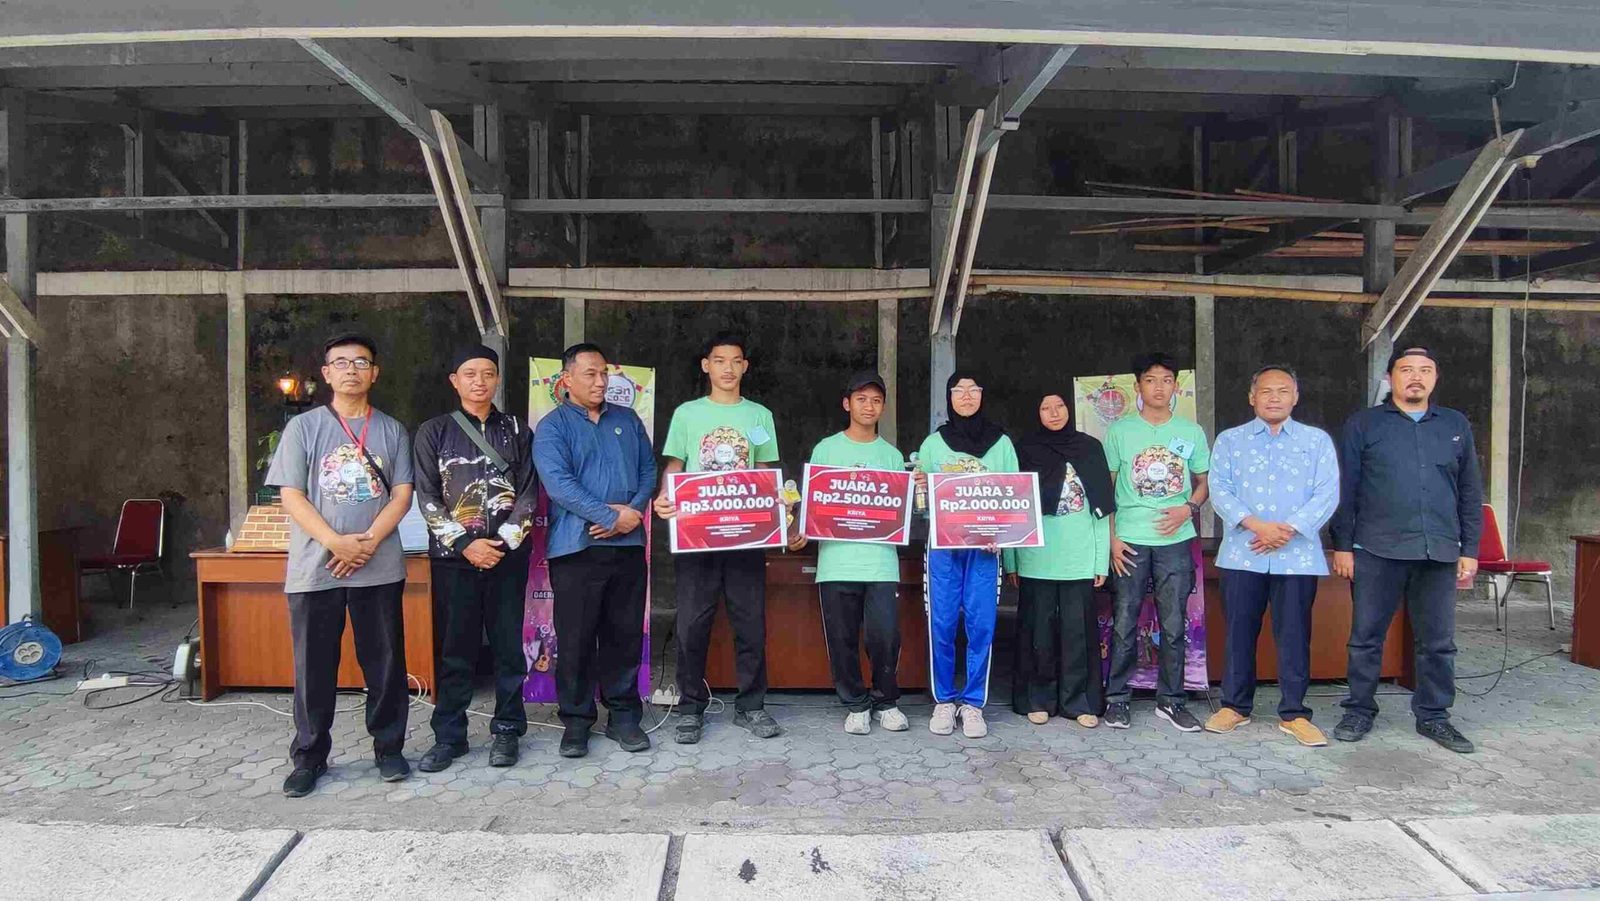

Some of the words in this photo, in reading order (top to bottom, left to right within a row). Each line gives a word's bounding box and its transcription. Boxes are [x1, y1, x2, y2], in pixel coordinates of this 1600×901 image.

[1176, 445, 1185, 453] 4
[697, 484, 749, 497] JUARA
[750, 483, 757, 495] 1
[829, 479, 876, 493] JUARA
[880, 483, 889, 494] 2
[955, 486, 1003, 497] JUARA
[1005, 486, 1014, 497] 3
[680, 496, 775, 514] Rp3.000.000
[813, 490, 902, 508] Rp2.500.000
[940, 499, 1030, 513] Rp2.000.000
[846, 509, 866, 517] KRIYA
